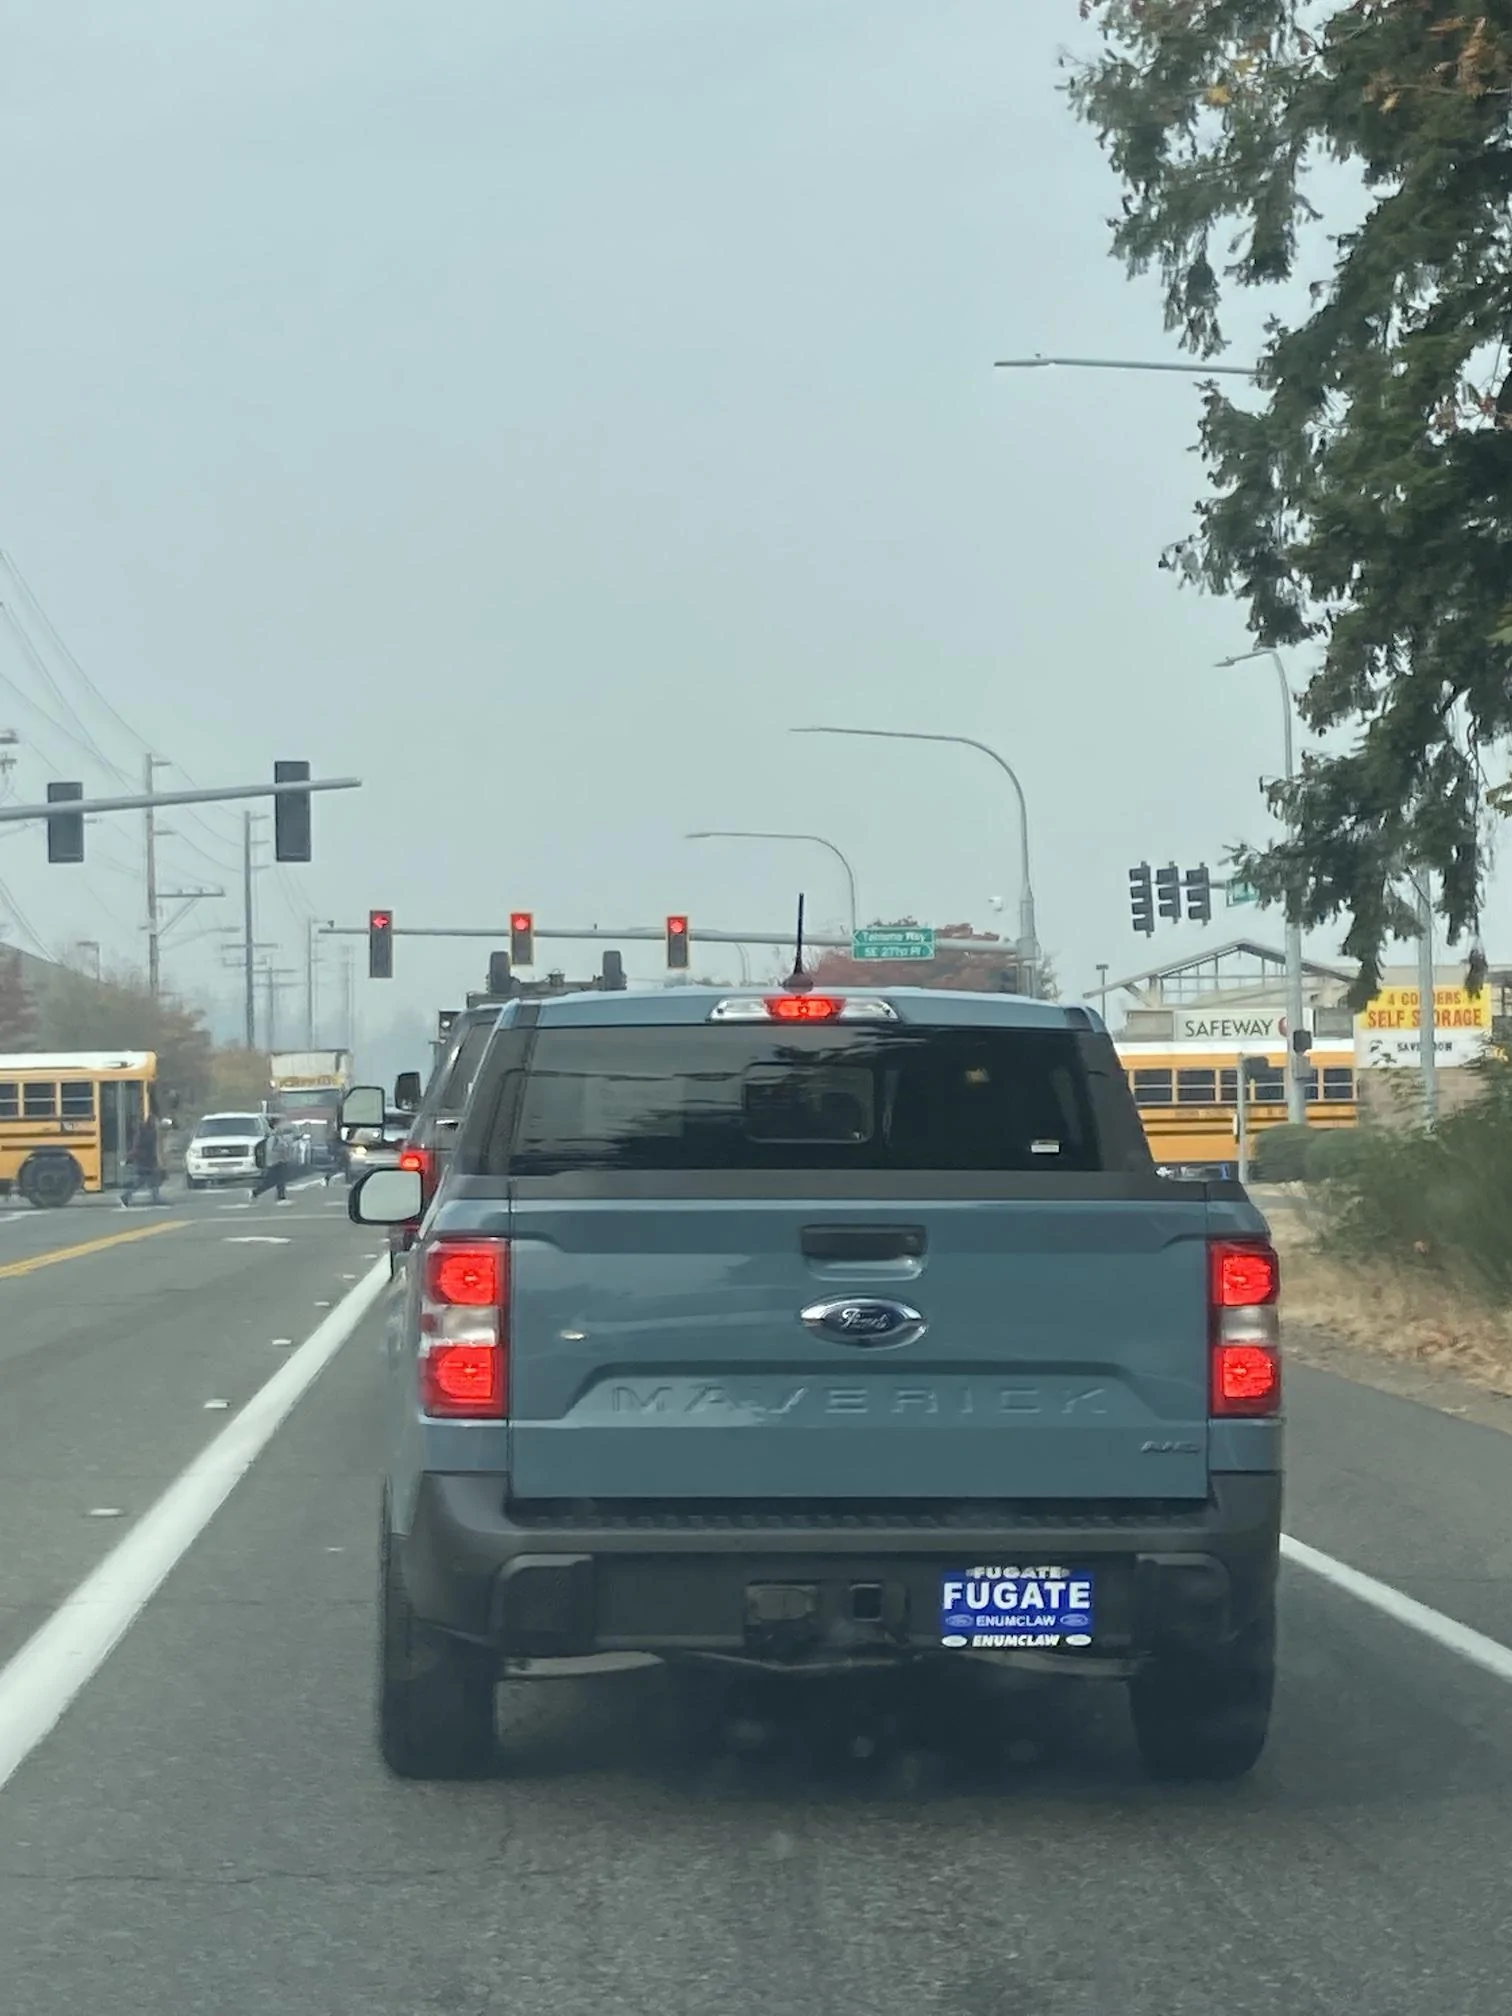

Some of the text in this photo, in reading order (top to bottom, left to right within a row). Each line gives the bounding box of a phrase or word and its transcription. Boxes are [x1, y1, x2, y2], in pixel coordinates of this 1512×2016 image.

[1185, 1018, 1274, 1037] SAFEWAY
[1367, 1008, 1482, 1028] SELF SORAGE
[839, 1307, 889, 1328] Ford
[611, 1386, 1107, 1414] MAVERICK
[973, 1565, 1061, 1579] FUGATE
[943, 1581, 1091, 1610] FUGATE
[976, 1615, 1056, 1627] ENUMCLAW
[972, 1634, 1060, 1647] ENUMCLAW
